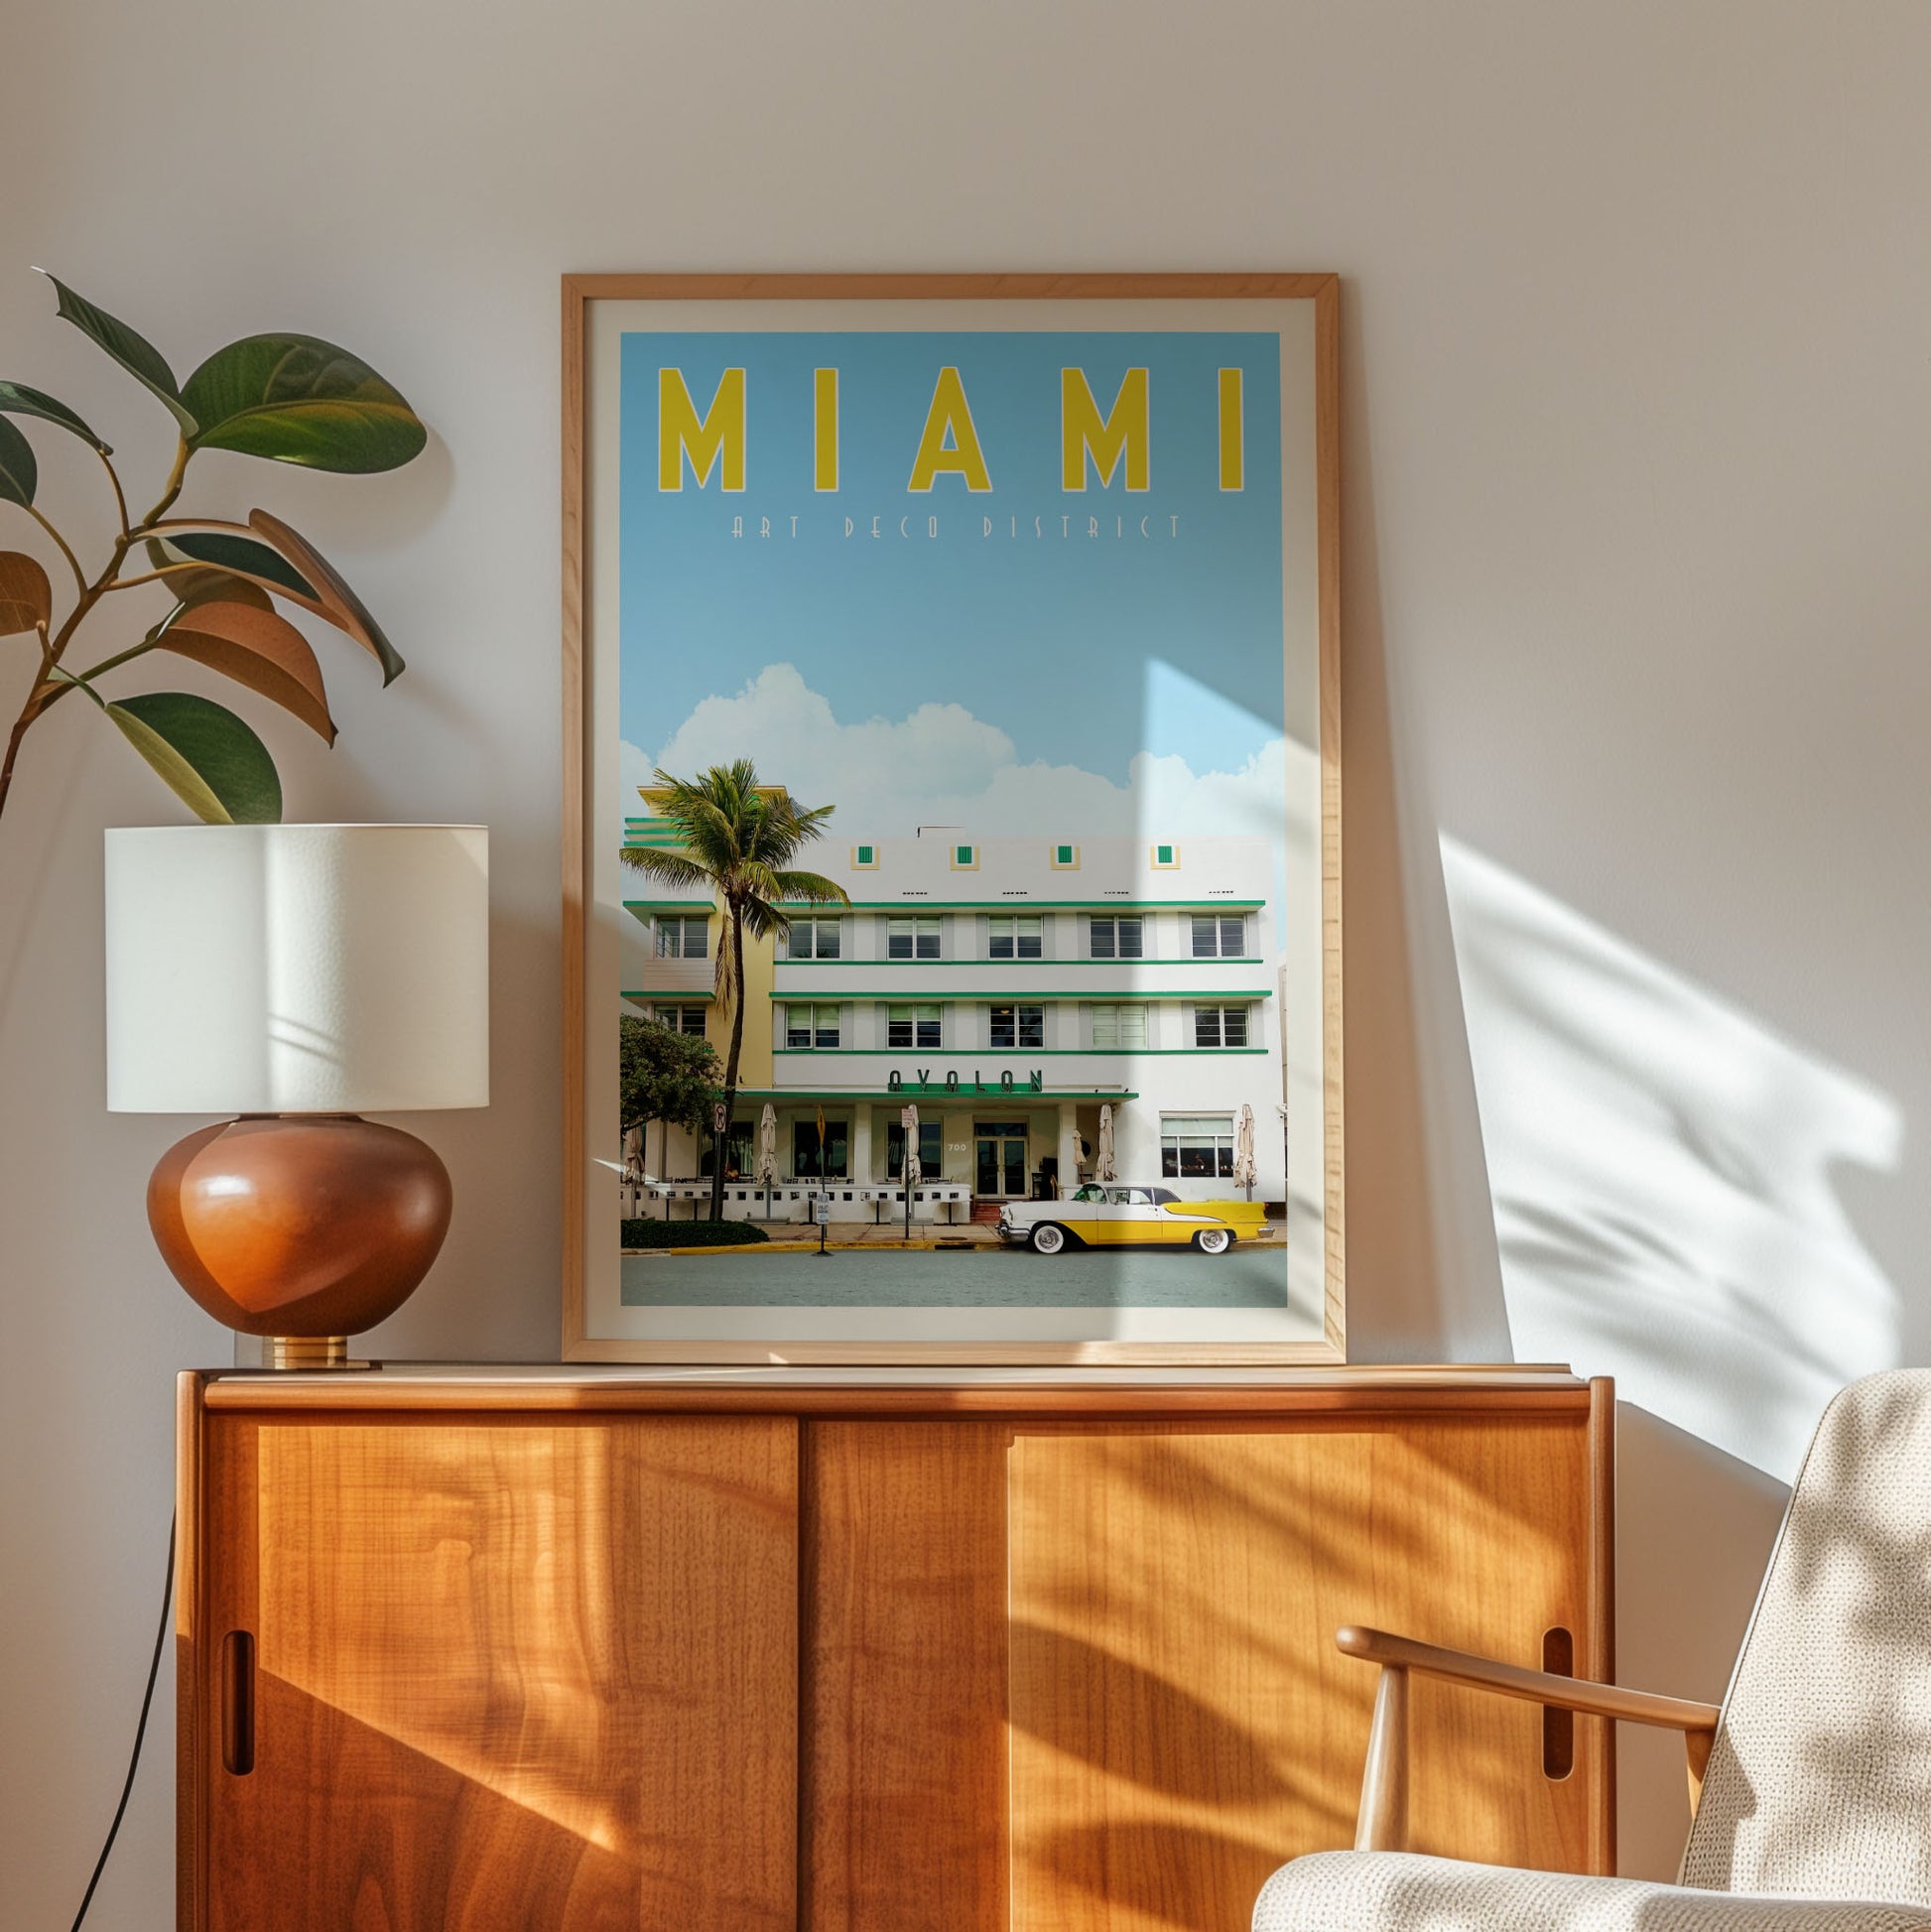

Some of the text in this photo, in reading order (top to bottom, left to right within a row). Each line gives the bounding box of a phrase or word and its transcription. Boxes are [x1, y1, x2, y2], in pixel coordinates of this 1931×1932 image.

[658, 366, 1244, 494] MIAMI
[731, 515, 1179, 539] ART DECO DISTRICT
[888, 1068, 1043, 1093] AVALON
[948, 1143, 967, 1152] 700
